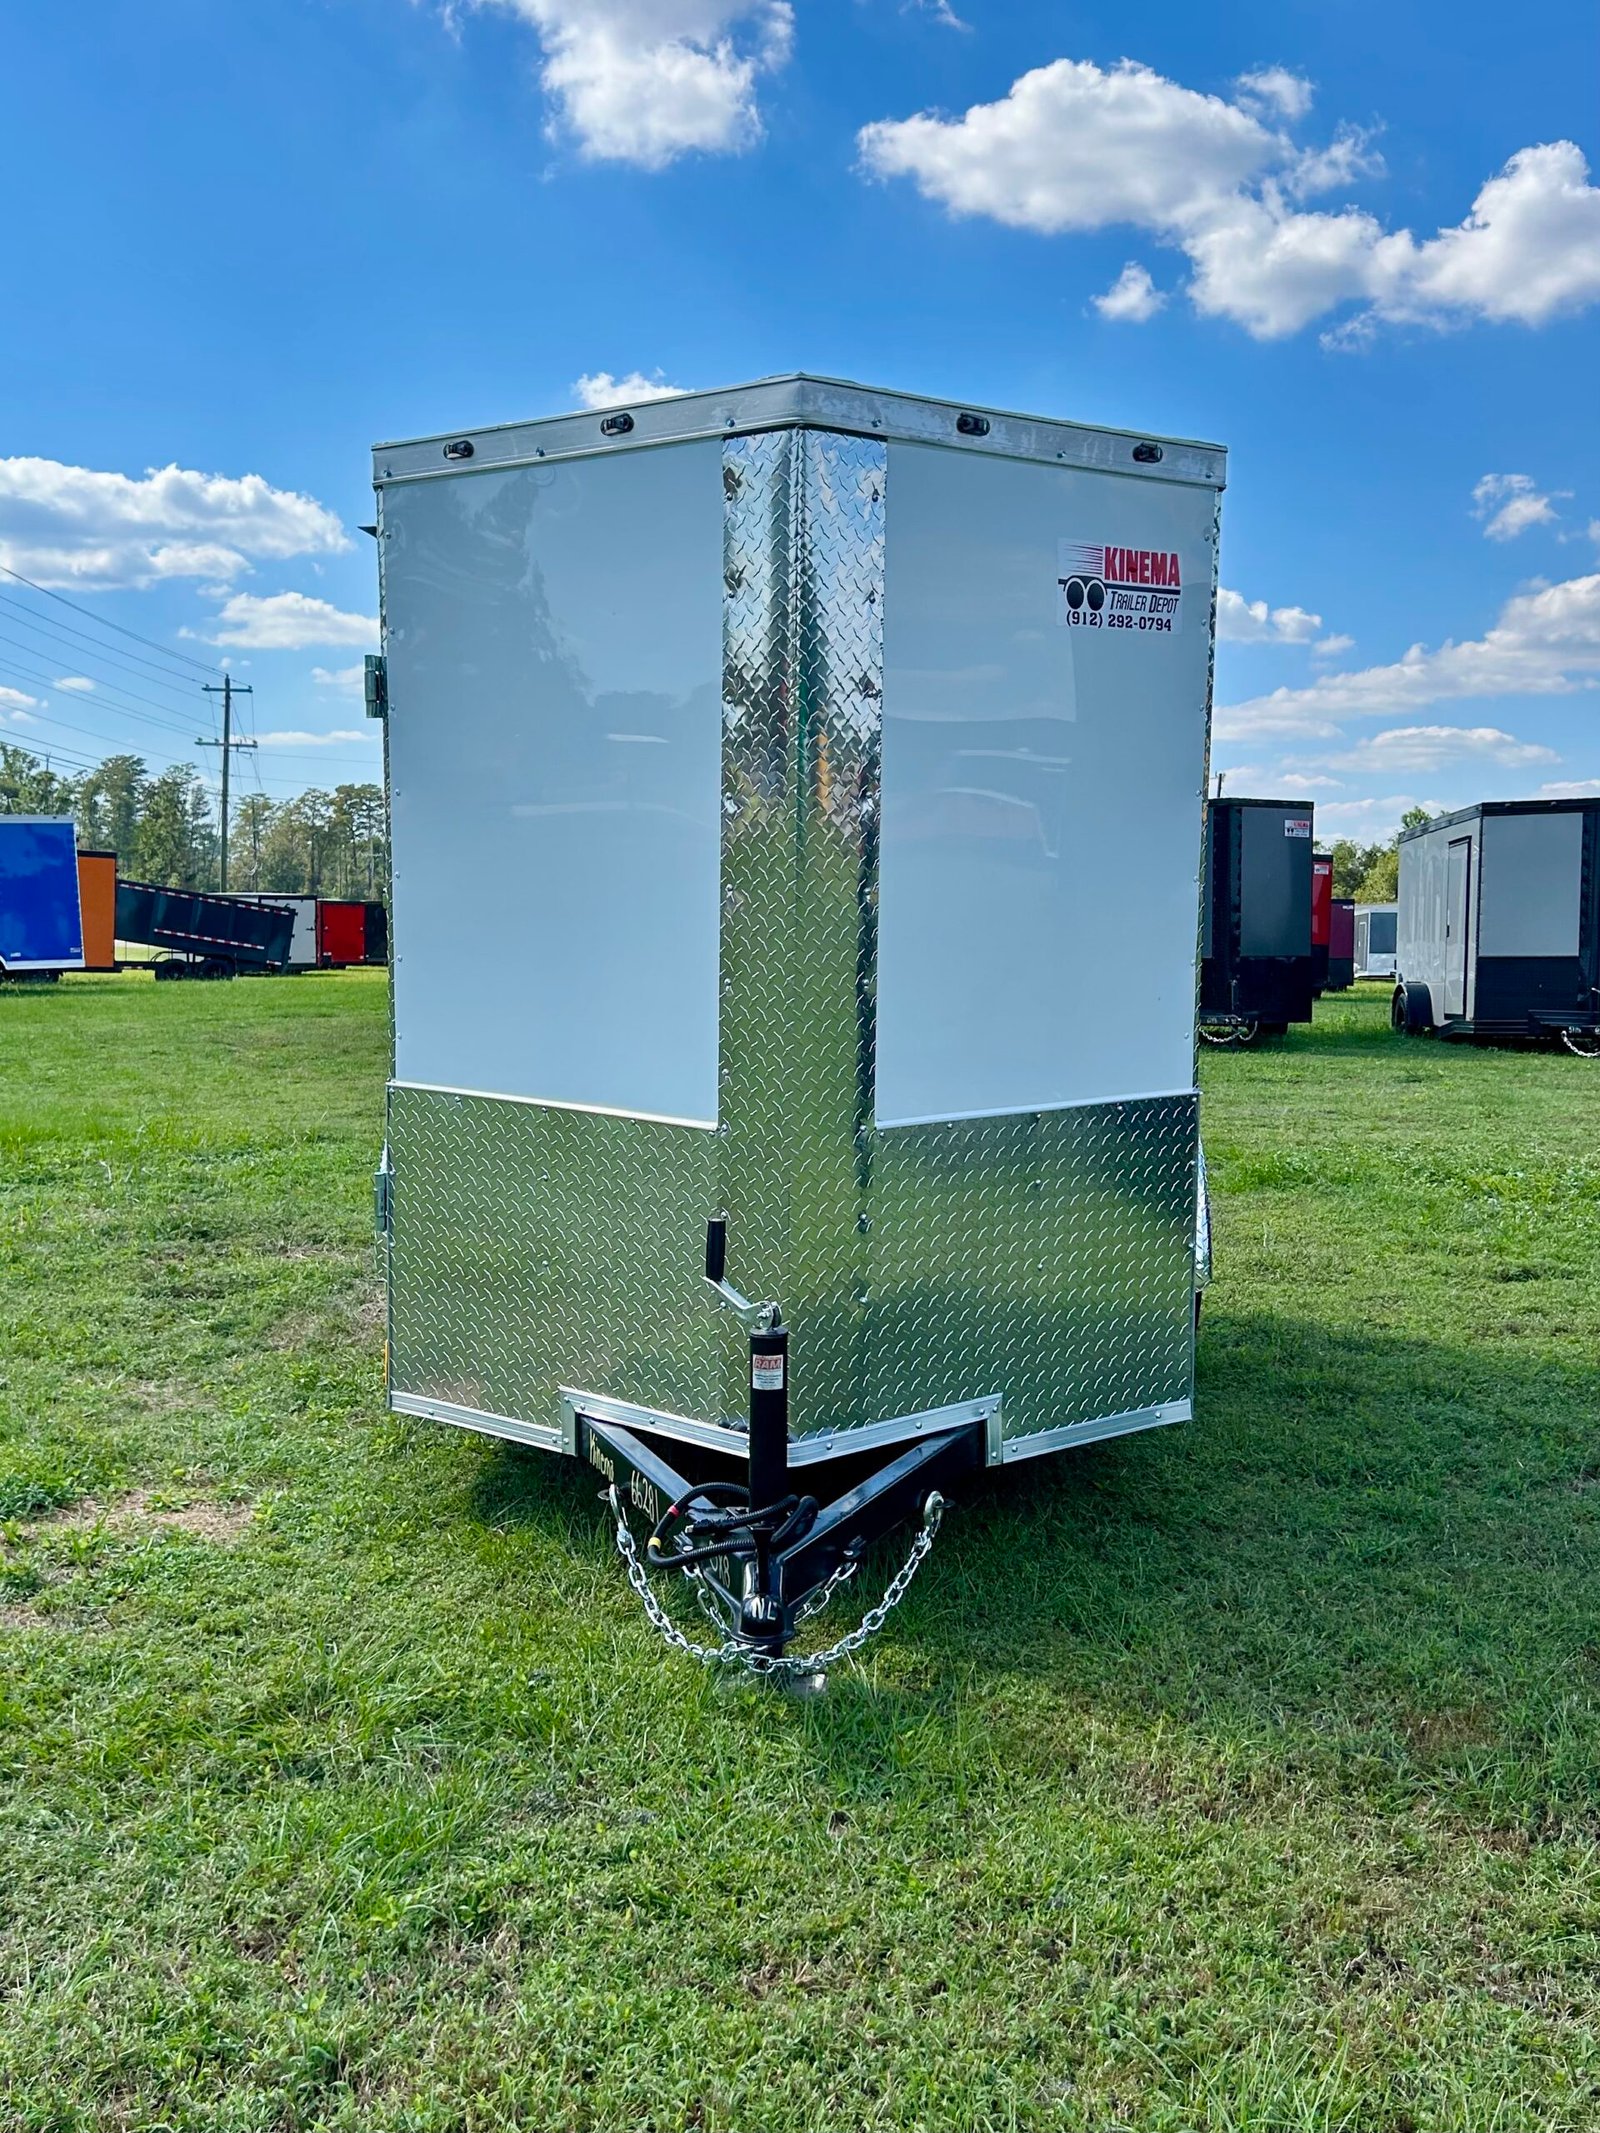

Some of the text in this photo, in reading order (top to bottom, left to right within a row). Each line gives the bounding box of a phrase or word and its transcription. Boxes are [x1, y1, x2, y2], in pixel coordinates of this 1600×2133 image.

[1104, 546, 1180, 586] KINEMA
[1110, 591, 1180, 614] TRAILER DEPOT
[1066, 610, 1172, 631] (912) 292-0794
[755, 1359, 781, 1369] RAM
[631, 1469, 660, 1525] 66281
